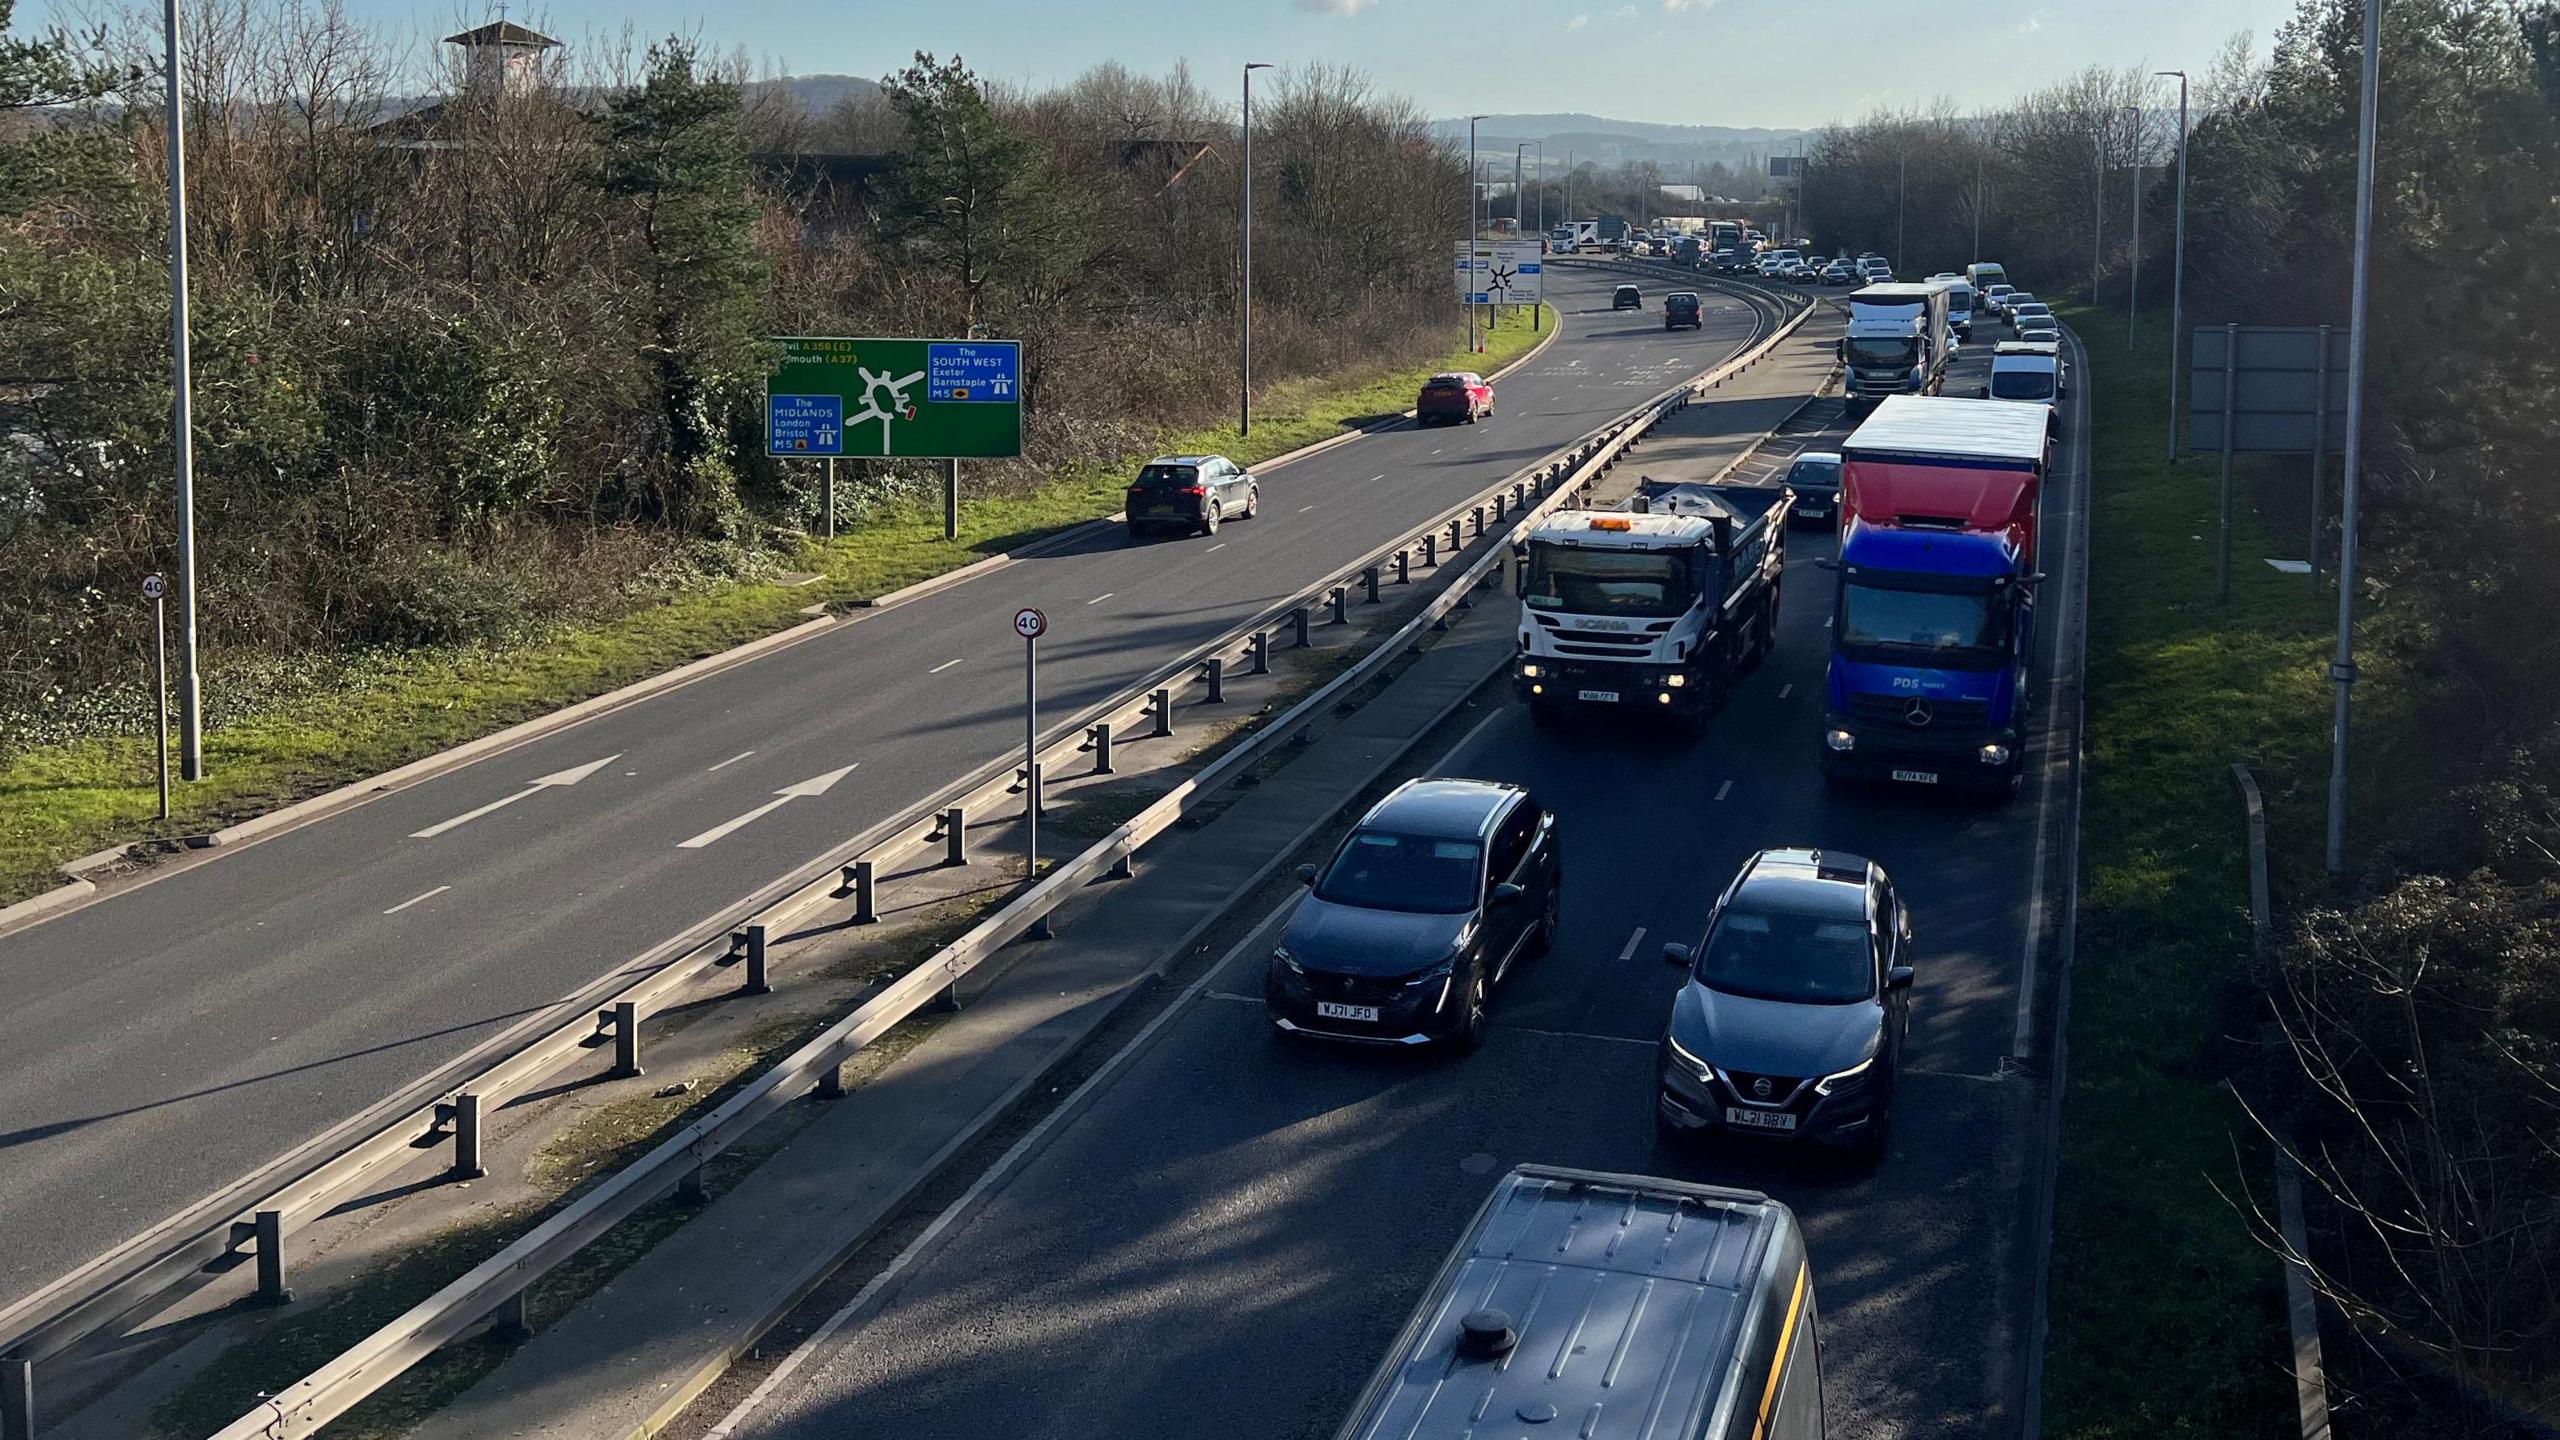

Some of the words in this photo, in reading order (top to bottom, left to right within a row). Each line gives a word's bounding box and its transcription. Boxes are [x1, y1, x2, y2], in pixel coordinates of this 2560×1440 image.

[959, 348, 977, 357] The
[825, 354, 858, 365] (A37)
[932, 357, 969, 366] SOUTH
[973, 358, 1003, 367] WEST
[932, 367, 965, 376] Exeter
[933, 378, 986, 387] Barnstaple
[795, 398, 813, 407] The
[774, 408, 833, 418] MIDLANDS
[775, 418, 811, 427] London
[775, 428, 809, 438] Bristol
[145, 581, 163, 593] 40
[1018, 617, 1039, 630] 40
[1893, 677, 1920, 689] PDS
[1324, 1003, 1348, 1016] WJ71
